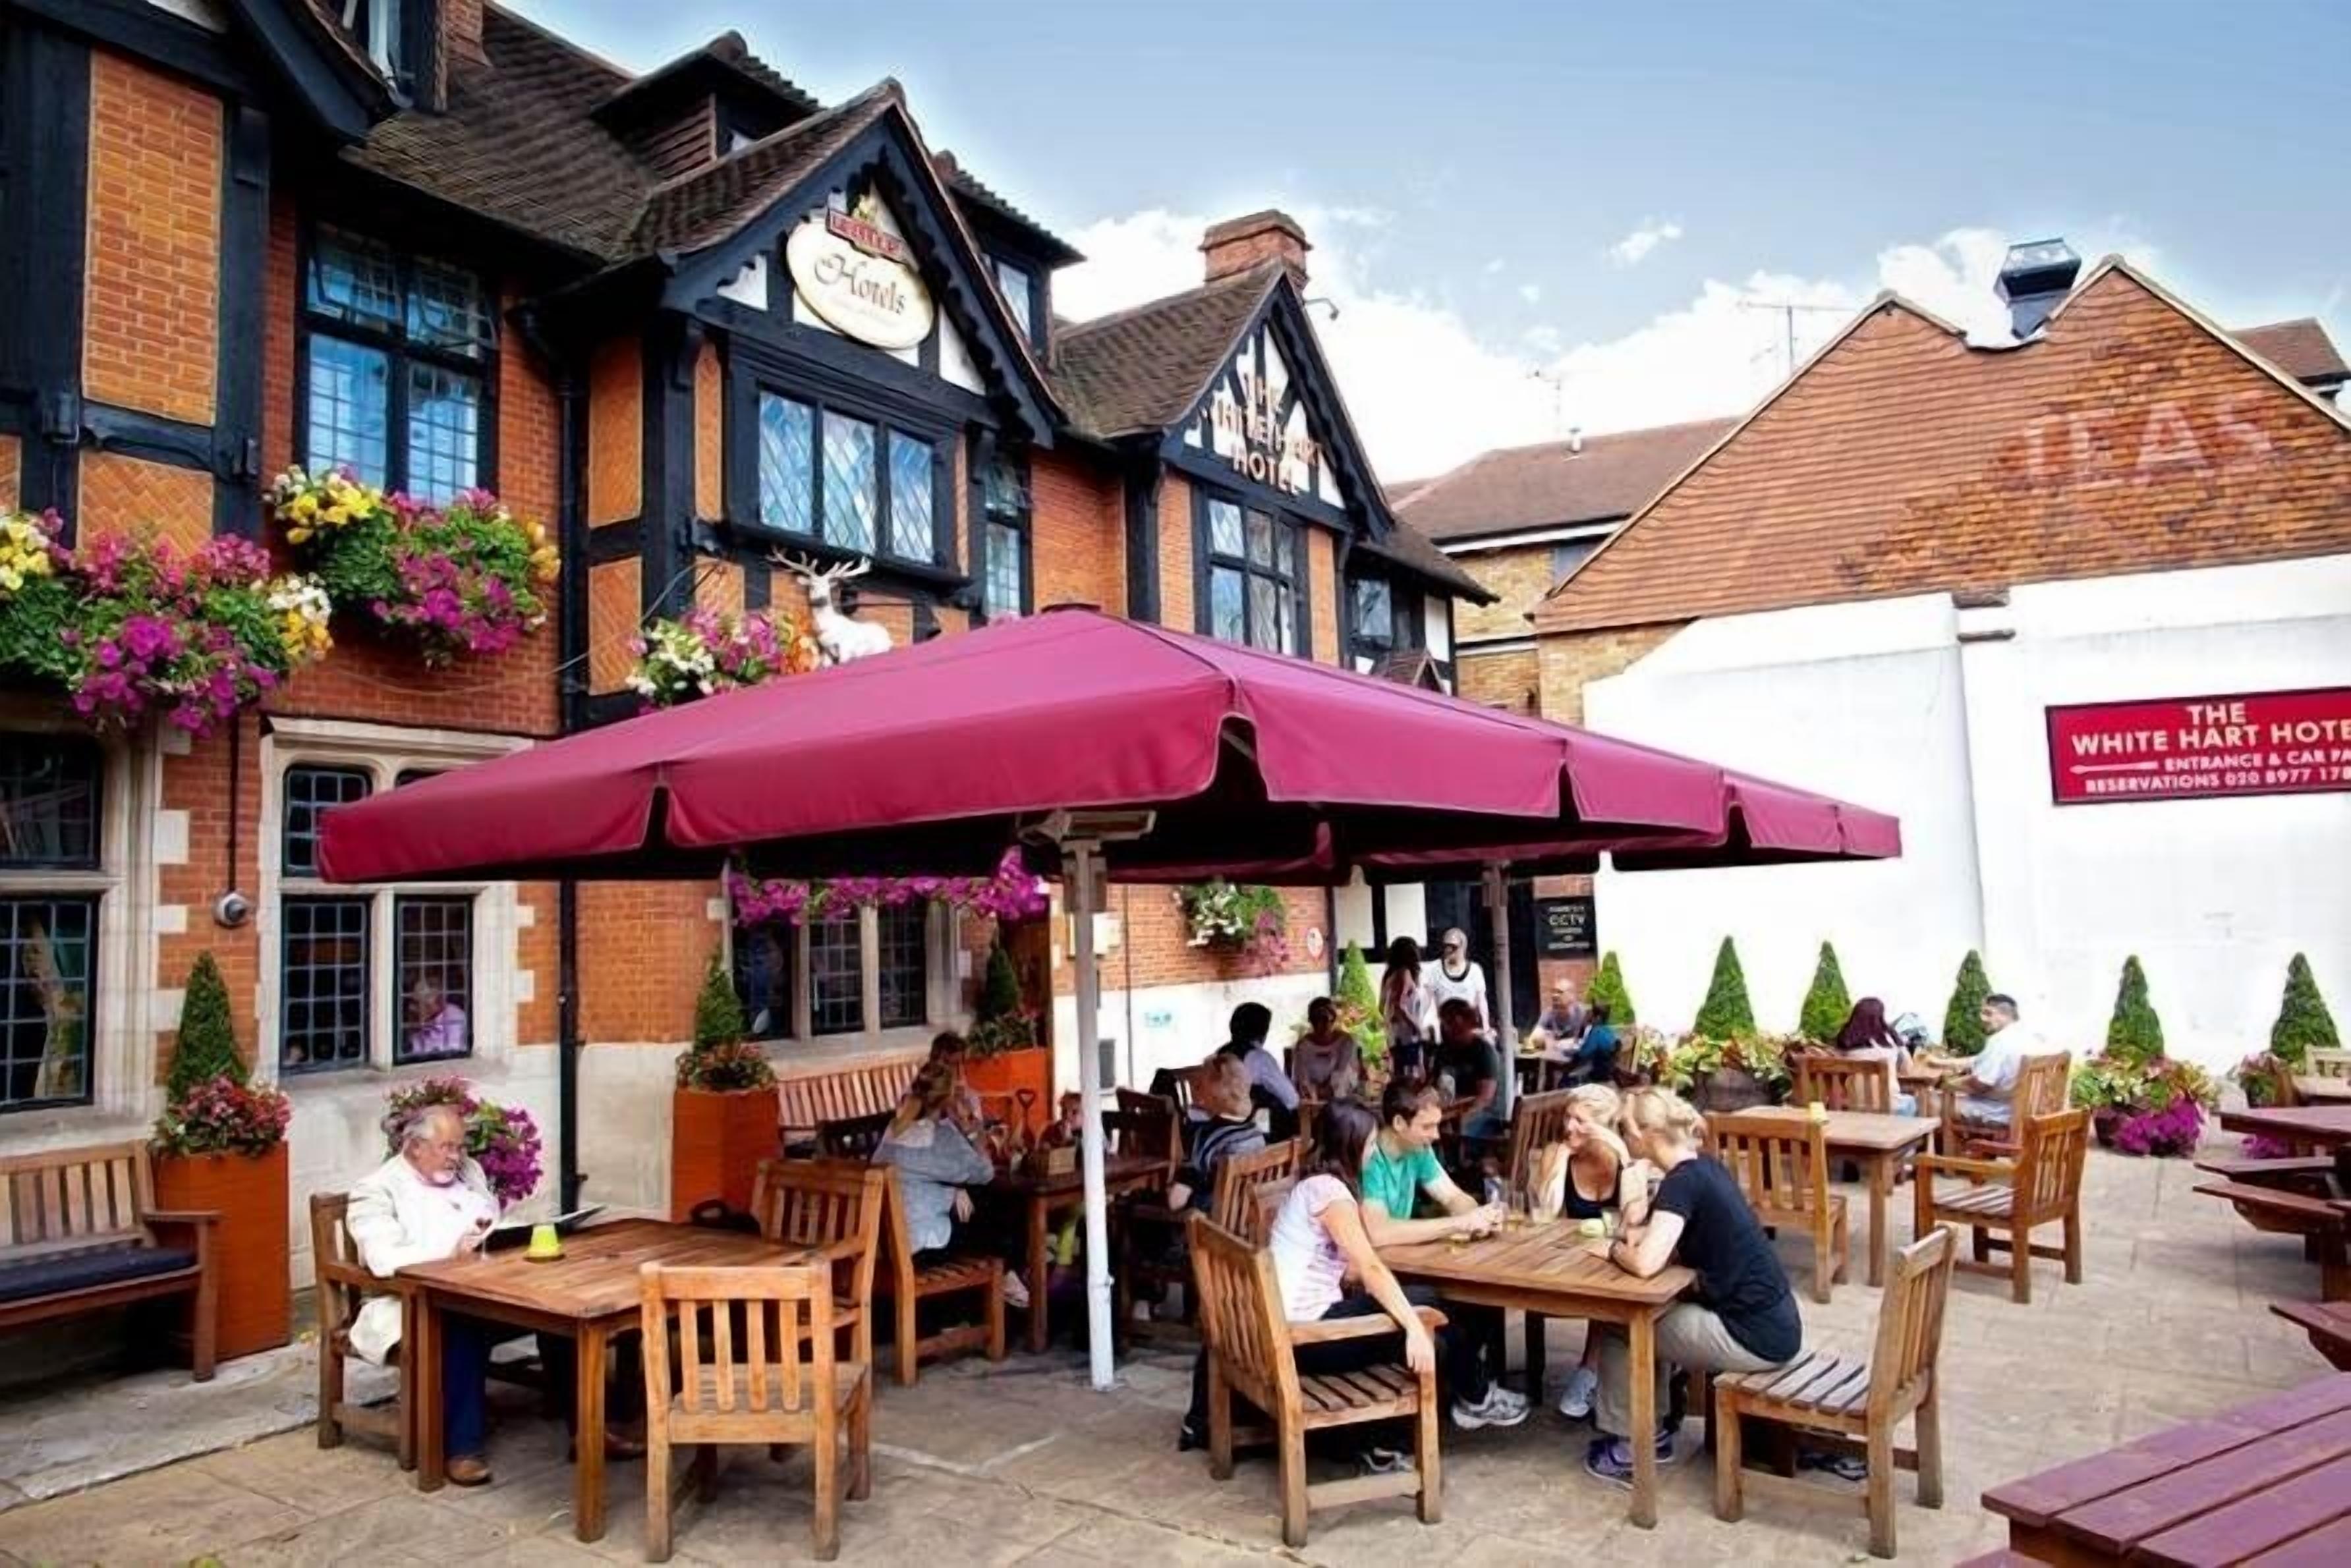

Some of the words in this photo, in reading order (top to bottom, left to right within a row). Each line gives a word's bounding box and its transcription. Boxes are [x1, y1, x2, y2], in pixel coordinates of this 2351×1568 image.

[814, 253, 907, 315] Hotels
[1232, 443, 1300, 495] HOTEL
[2186, 702, 2247, 725] THE
[2072, 729, 2169, 756] WHITE
[2178, 725, 2260, 750] HART
[2270, 719, 2351, 744] HOTE
[2164, 752, 2263, 772] ENTRANCE
[2286, 748, 2325, 764] CAR
[2085, 771, 2220, 793] RESERVATIONS
[2265, 768, 2311, 783] 8977
